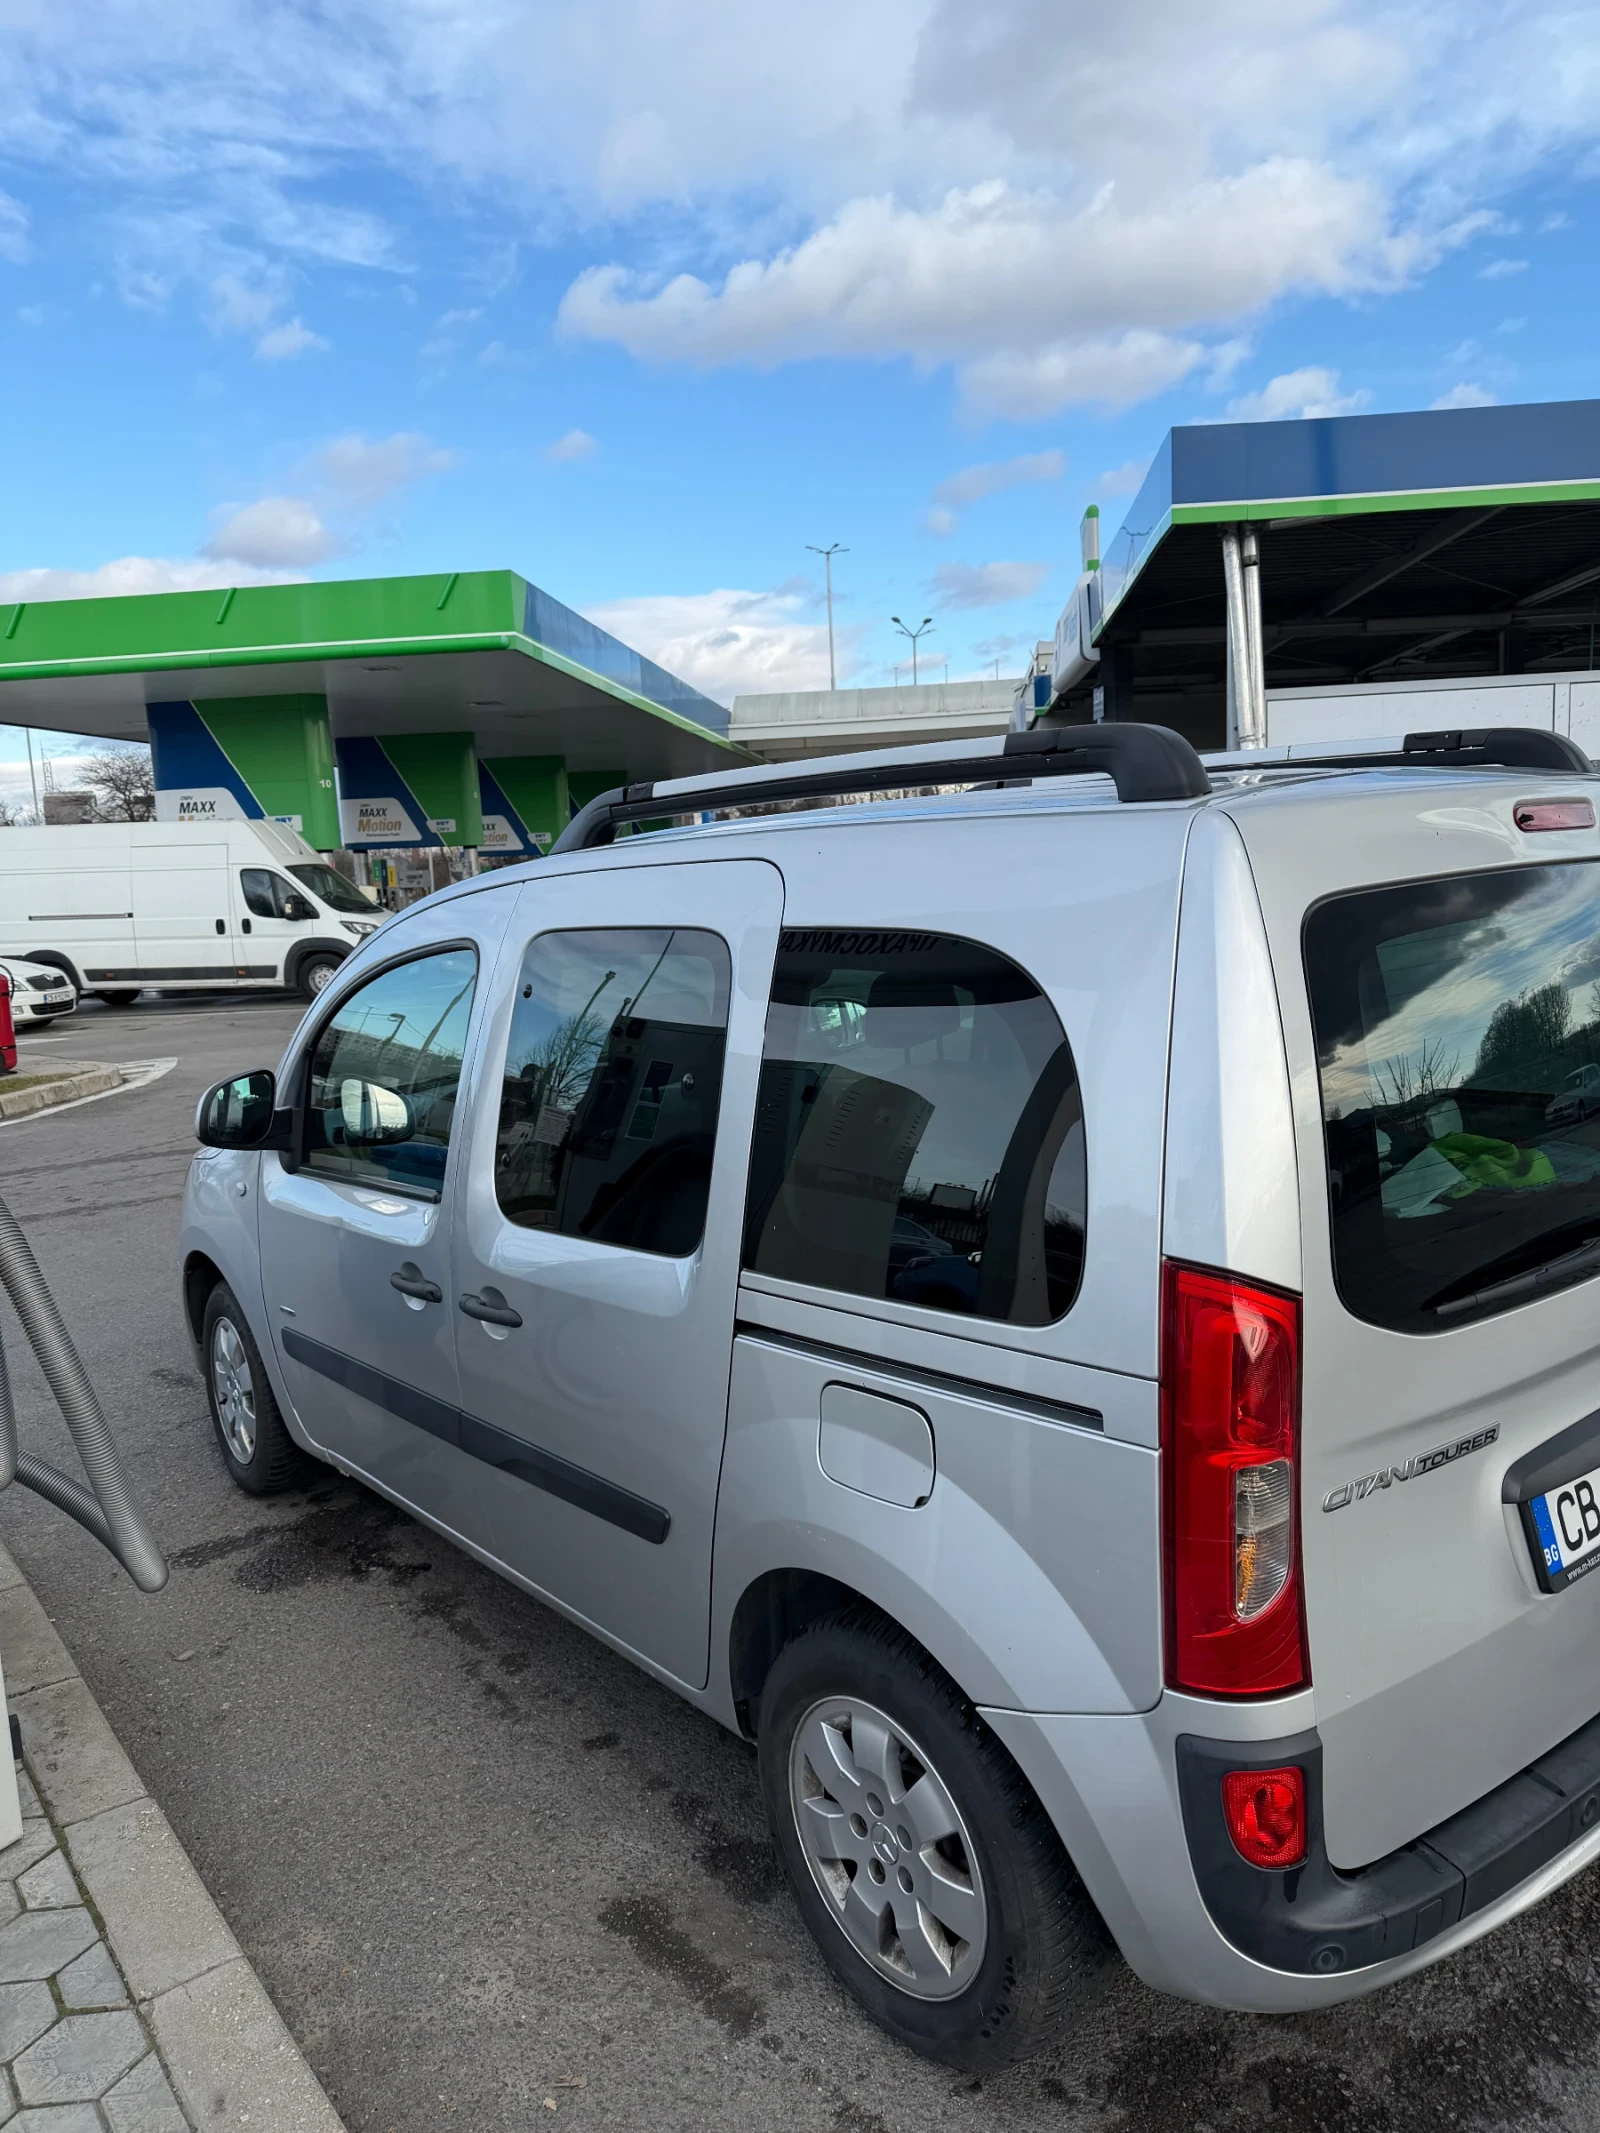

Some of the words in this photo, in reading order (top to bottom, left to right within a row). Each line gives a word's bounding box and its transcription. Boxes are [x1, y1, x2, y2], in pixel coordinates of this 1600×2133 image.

[319, 779, 332, 788] 10
[179, 800, 216, 814] MAXX
[359, 807, 388, 818] MAXX
[358, 818, 402, 832] Motion
[483, 831, 508, 843] otion
[1322, 1458, 1410, 1513] CITAN
[1419, 1428, 1497, 1472] TOURER
[1556, 1480, 1600, 1551] CB
[1543, 1543, 1559, 1567] BG
